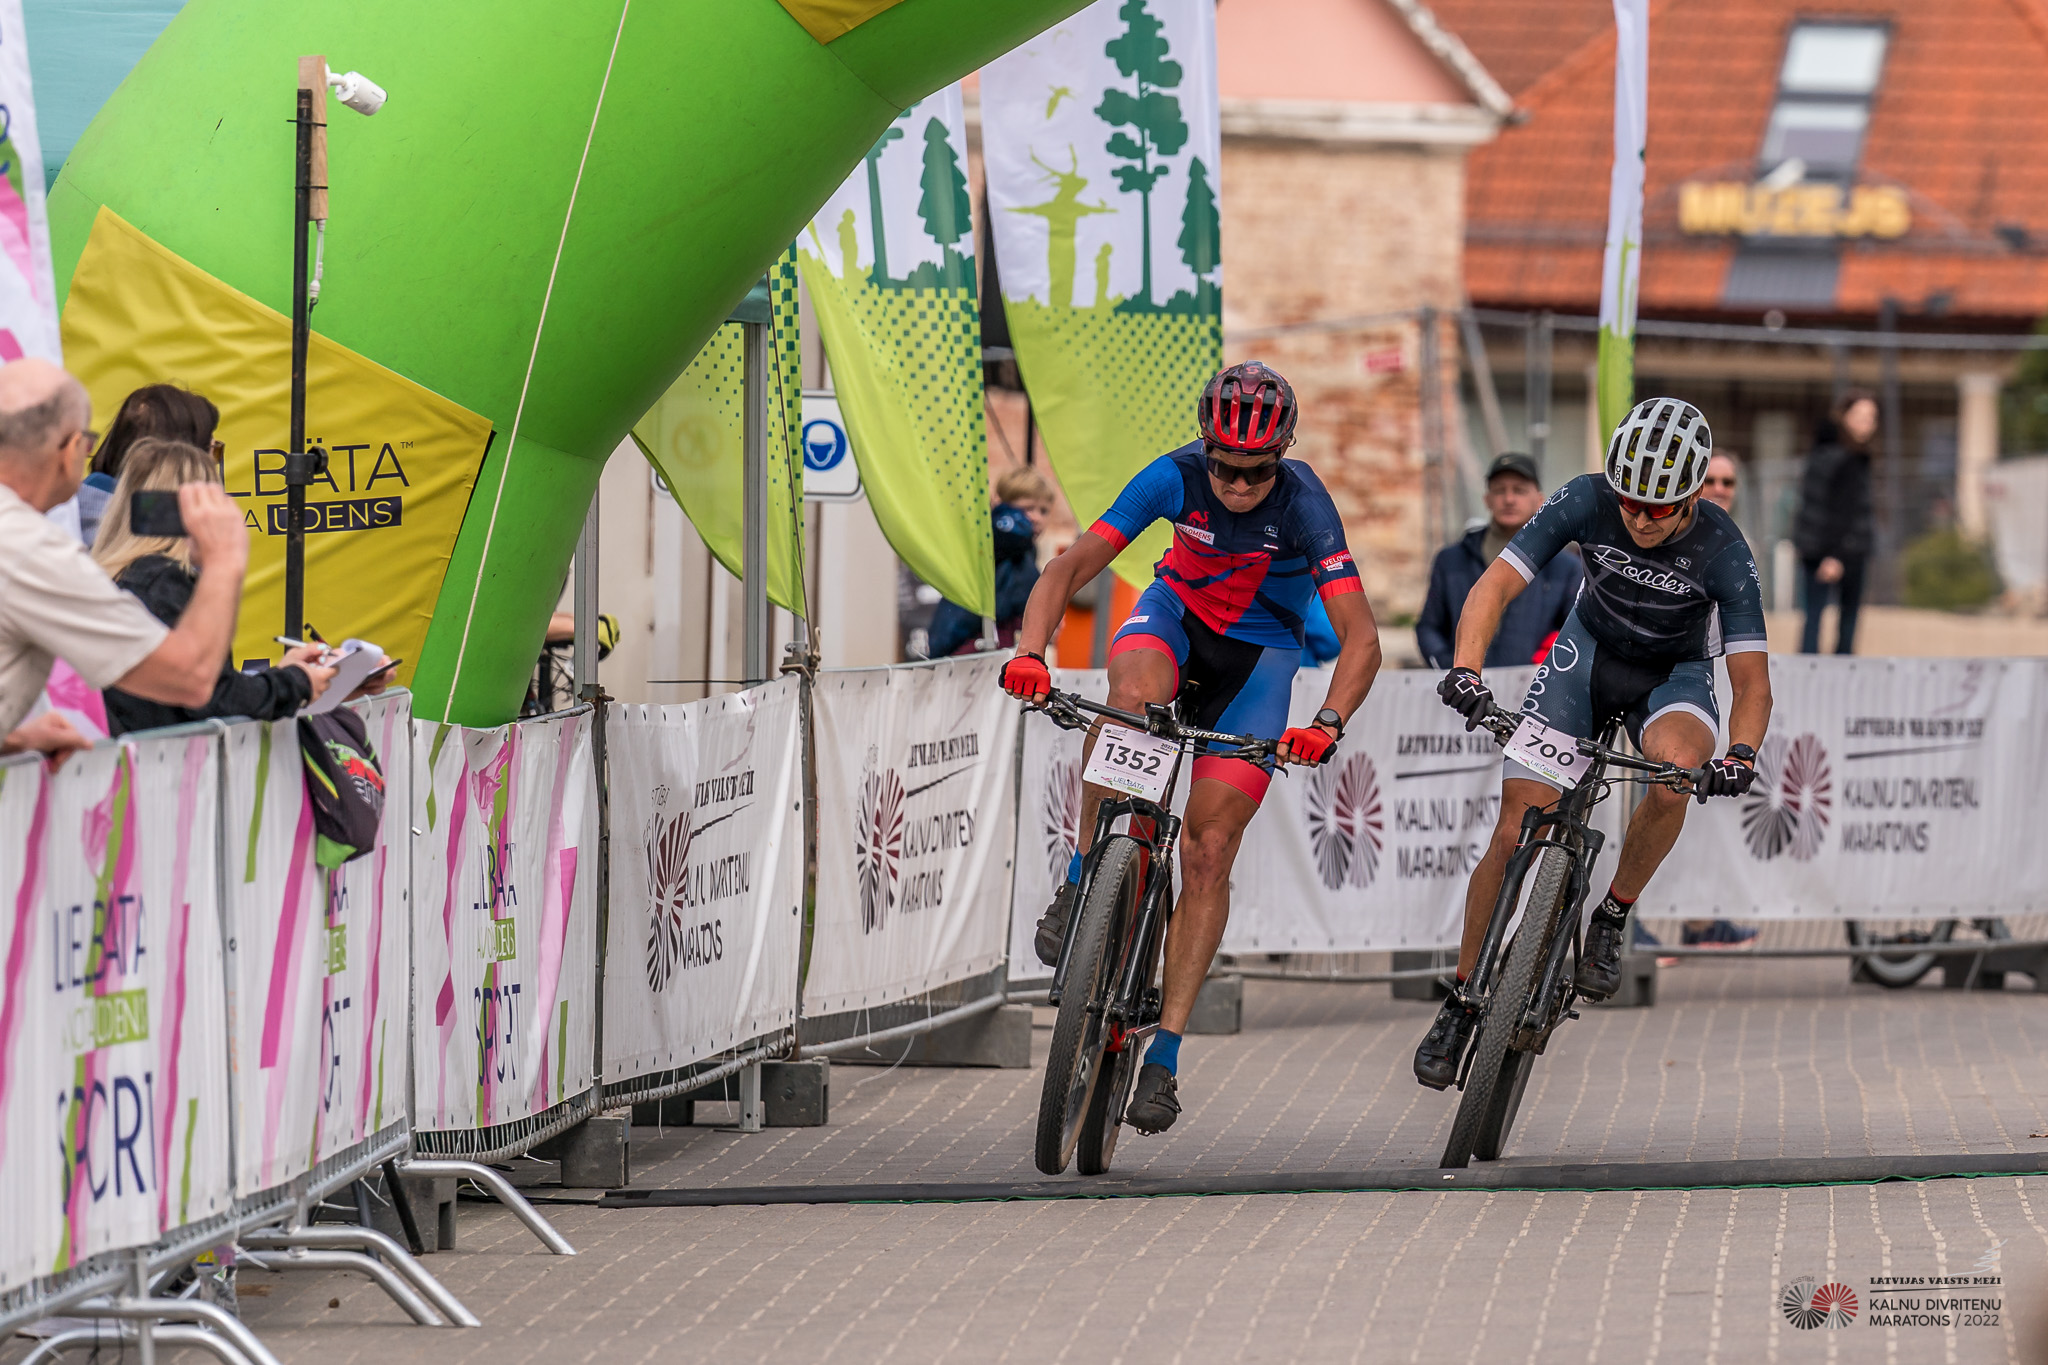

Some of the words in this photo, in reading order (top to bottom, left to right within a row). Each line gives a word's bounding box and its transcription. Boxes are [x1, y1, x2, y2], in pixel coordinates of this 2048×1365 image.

[1104, 743, 1161, 776] 1352
[1525, 734, 1575, 766] 700
[1395, 798, 1457, 832] KALNU
